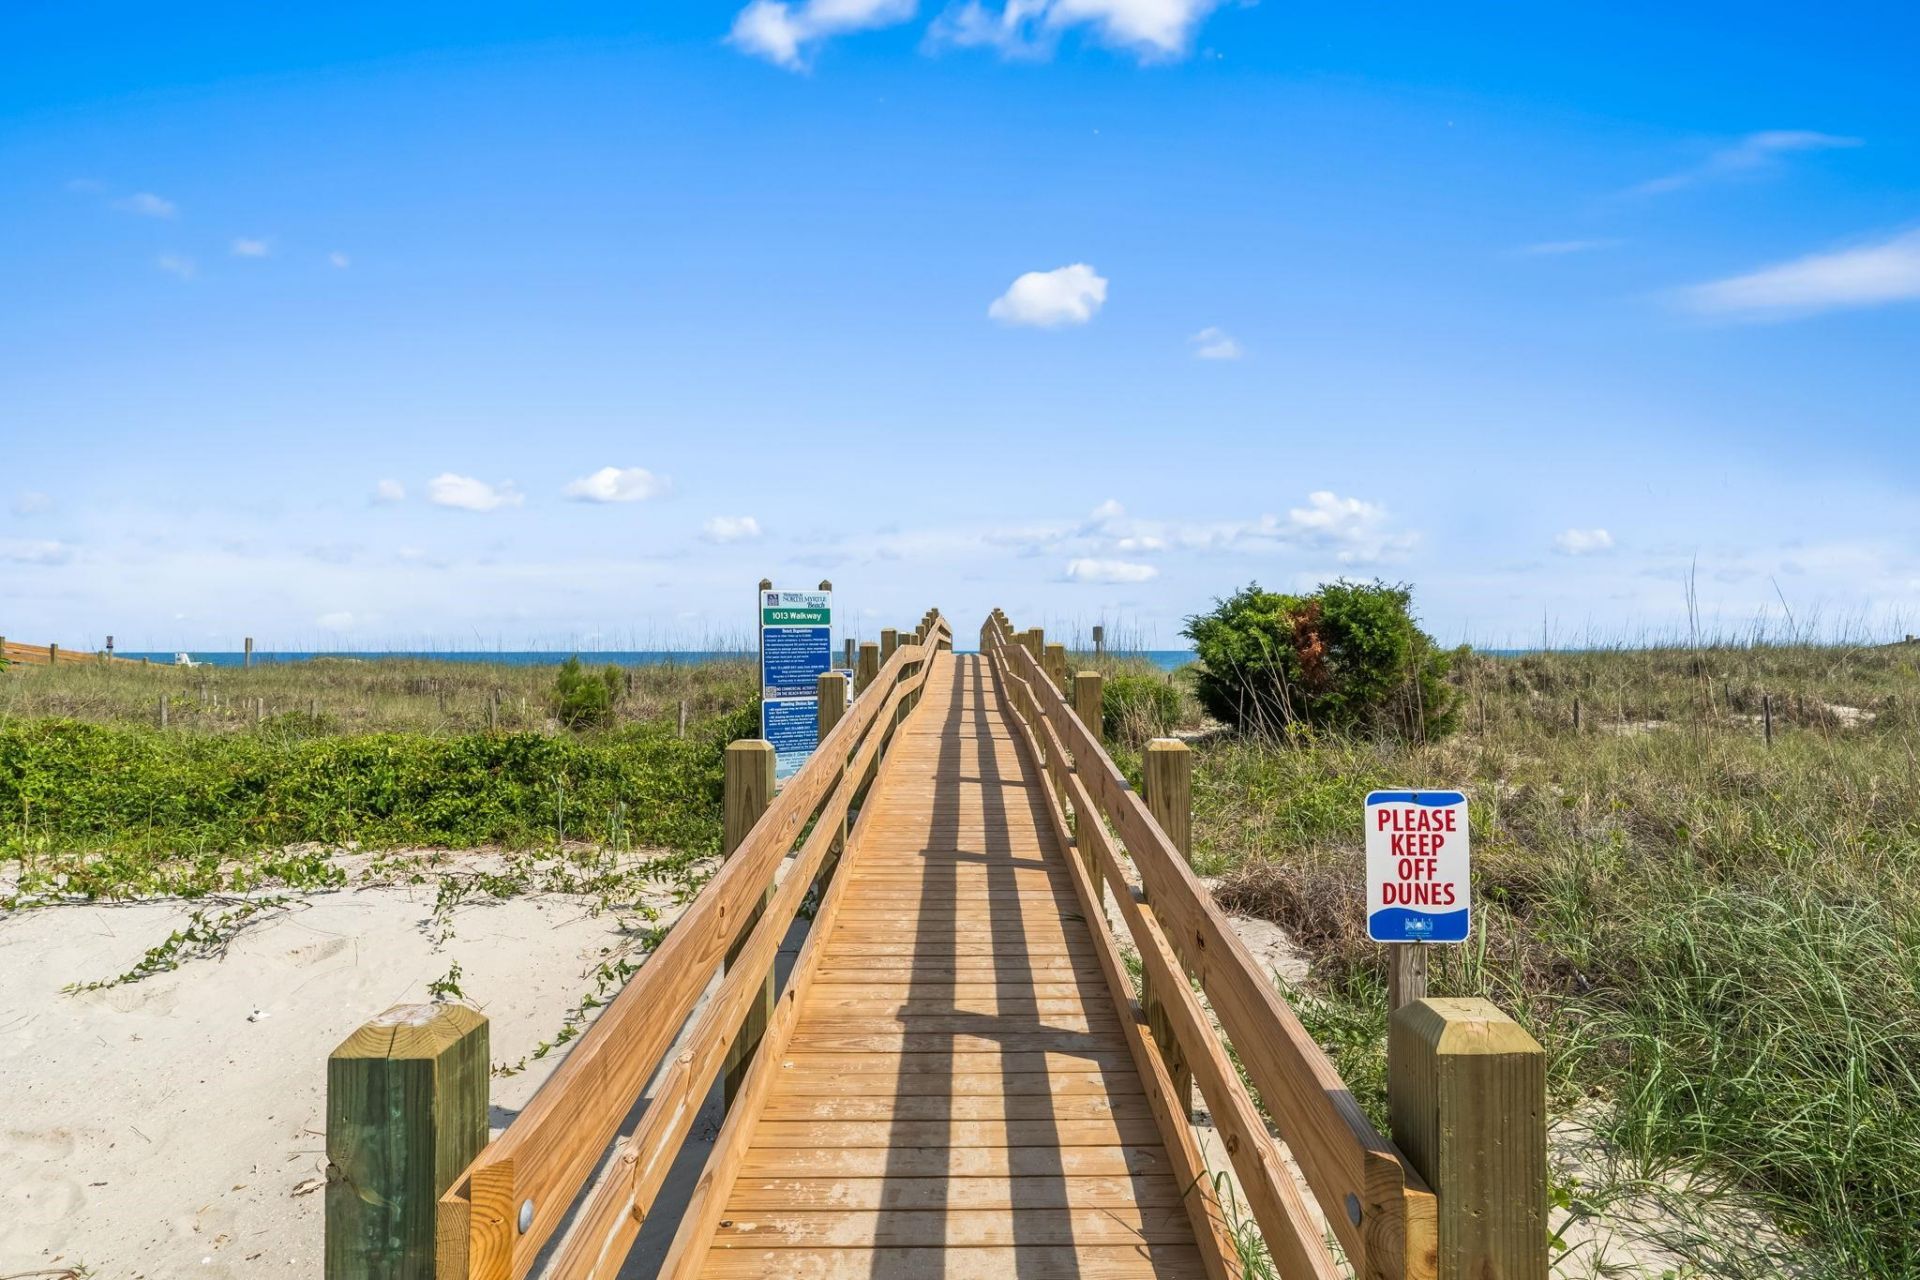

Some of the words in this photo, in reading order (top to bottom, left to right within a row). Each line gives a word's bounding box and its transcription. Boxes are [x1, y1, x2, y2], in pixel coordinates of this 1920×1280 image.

[772, 612, 789, 620] 1013
[790, 612, 822, 621] Walkway
[1377, 809, 1457, 832] PLEASE
[1391, 833, 1445, 856] KEEP
[1398, 858, 1438, 881] OFF
[1382, 883, 1456, 906] DUNES
